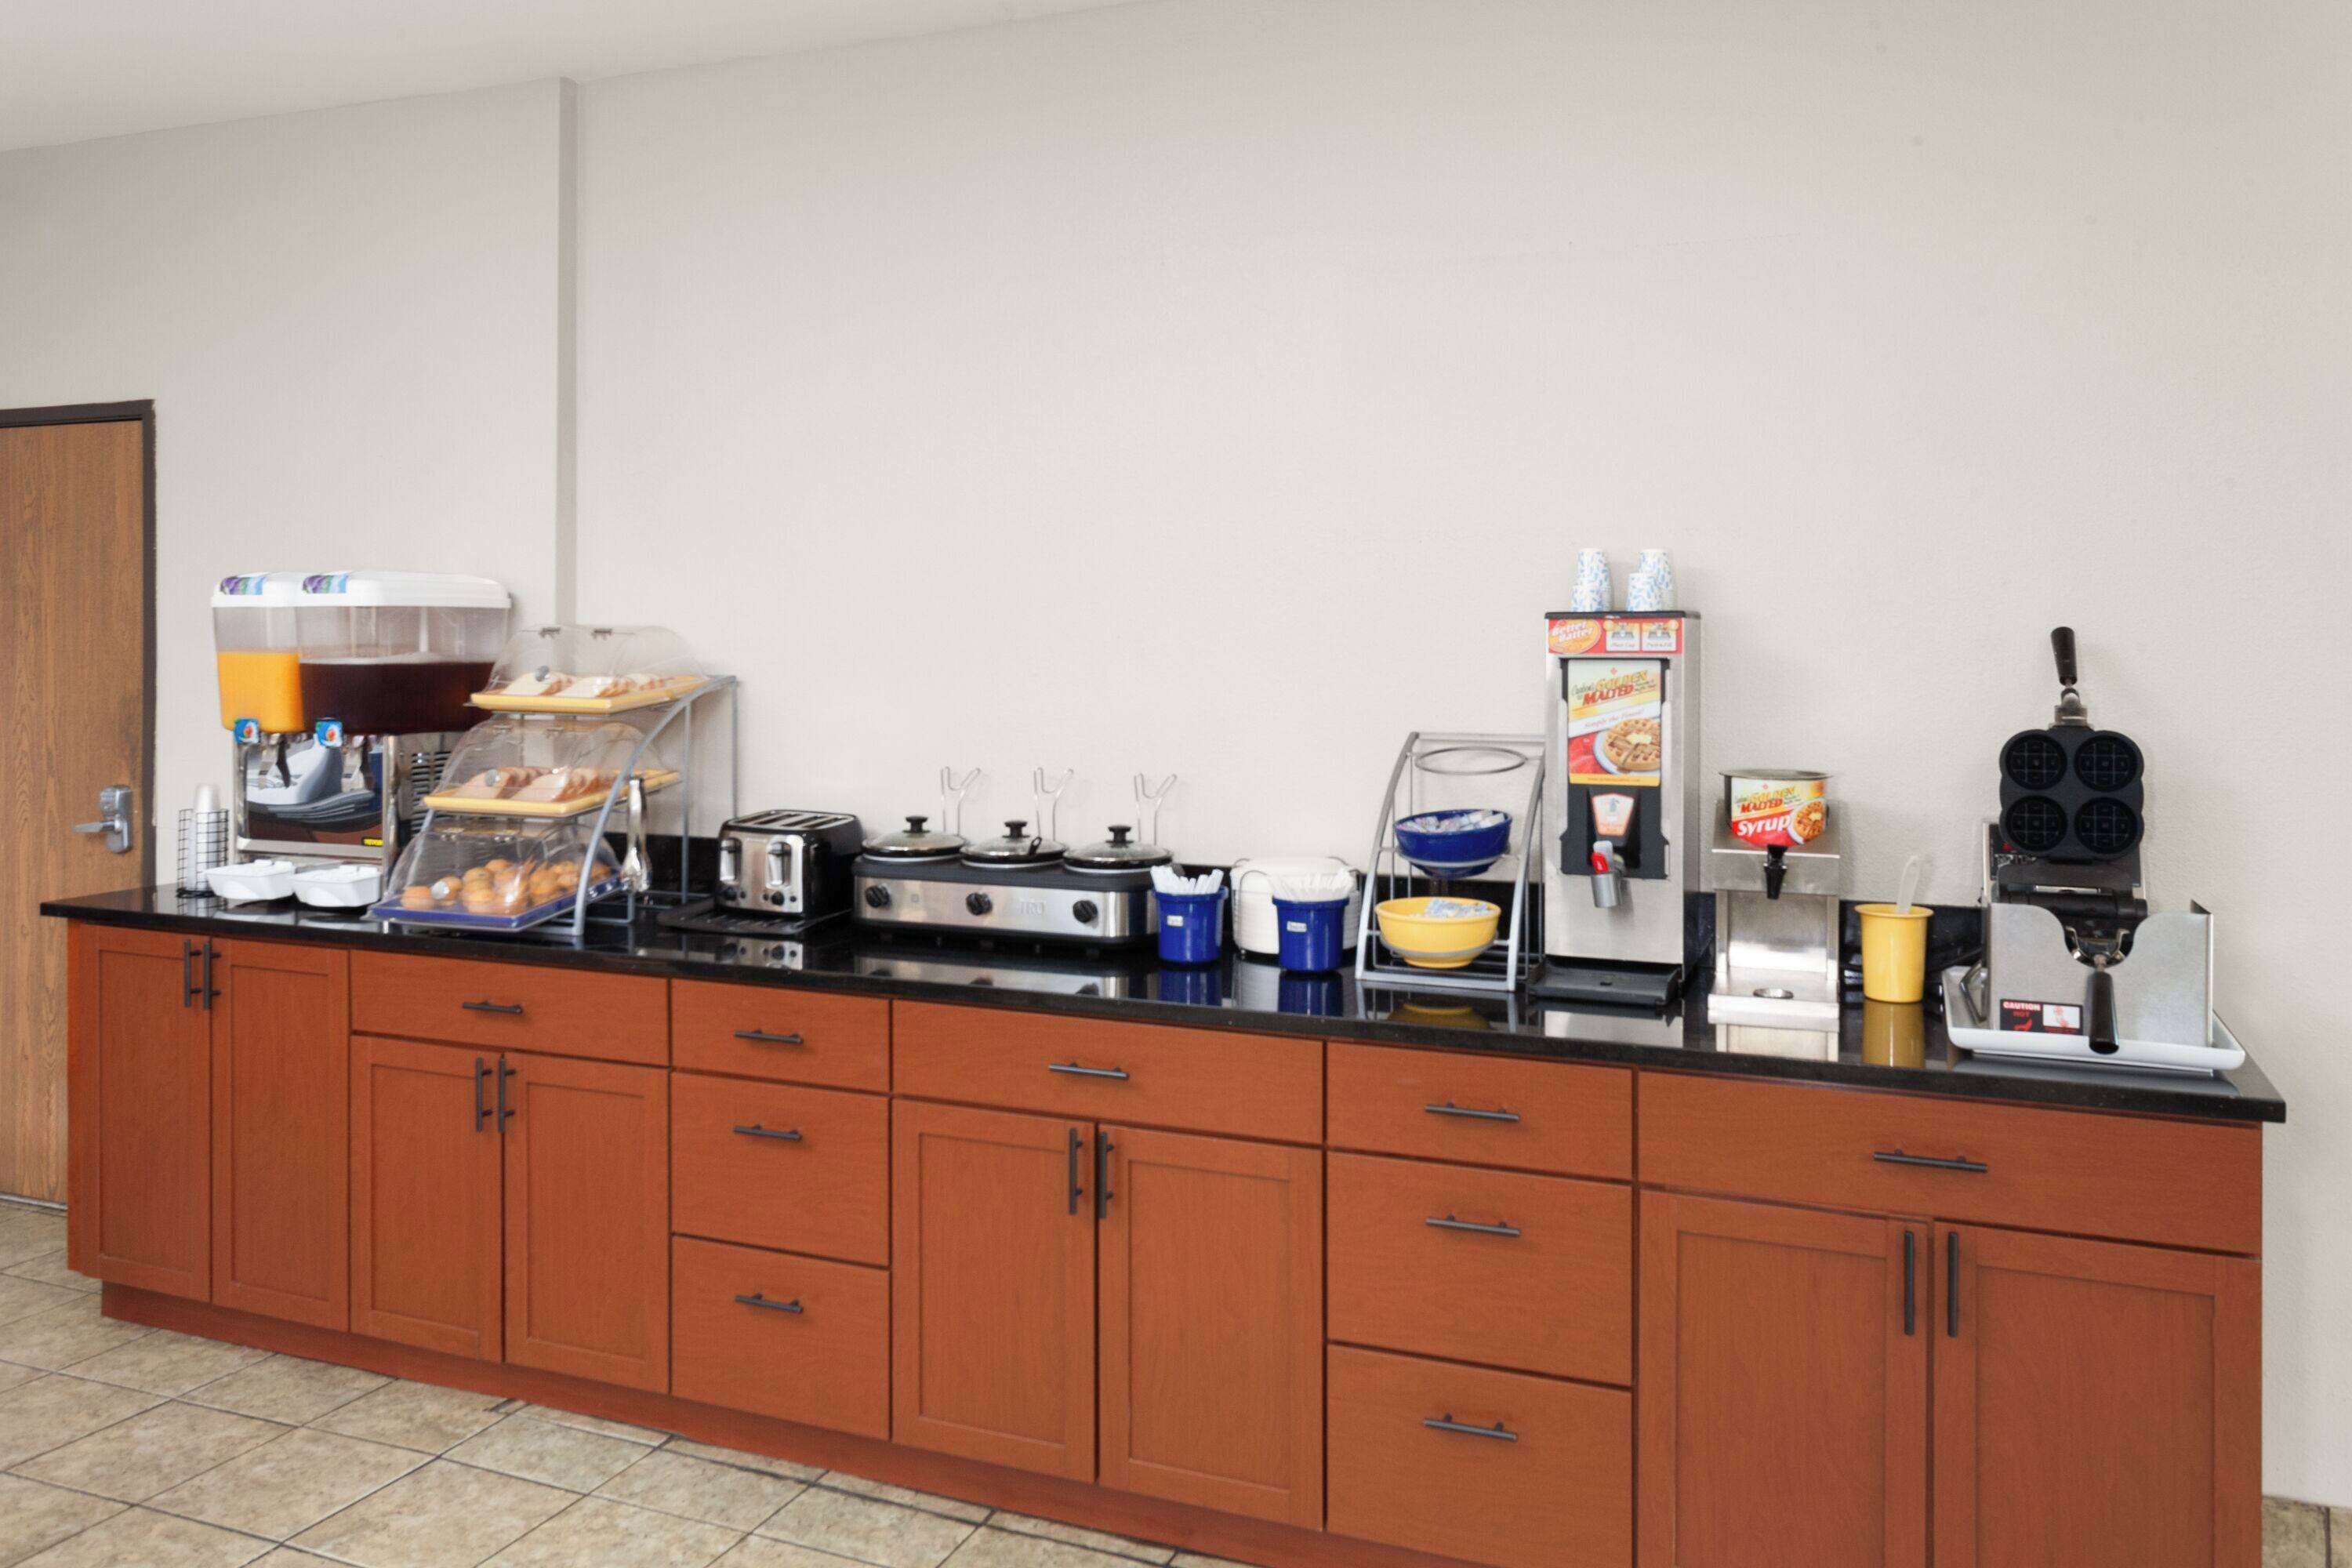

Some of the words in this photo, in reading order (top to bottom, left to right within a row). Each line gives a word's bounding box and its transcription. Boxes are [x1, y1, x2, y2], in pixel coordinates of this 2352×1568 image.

[1582, 684, 1635, 706] MALTED
[1740, 797, 1784, 813] MALTED
[1737, 815, 1791, 836] Syrup
[2002, 1000, 2042, 1011] CAUTION
